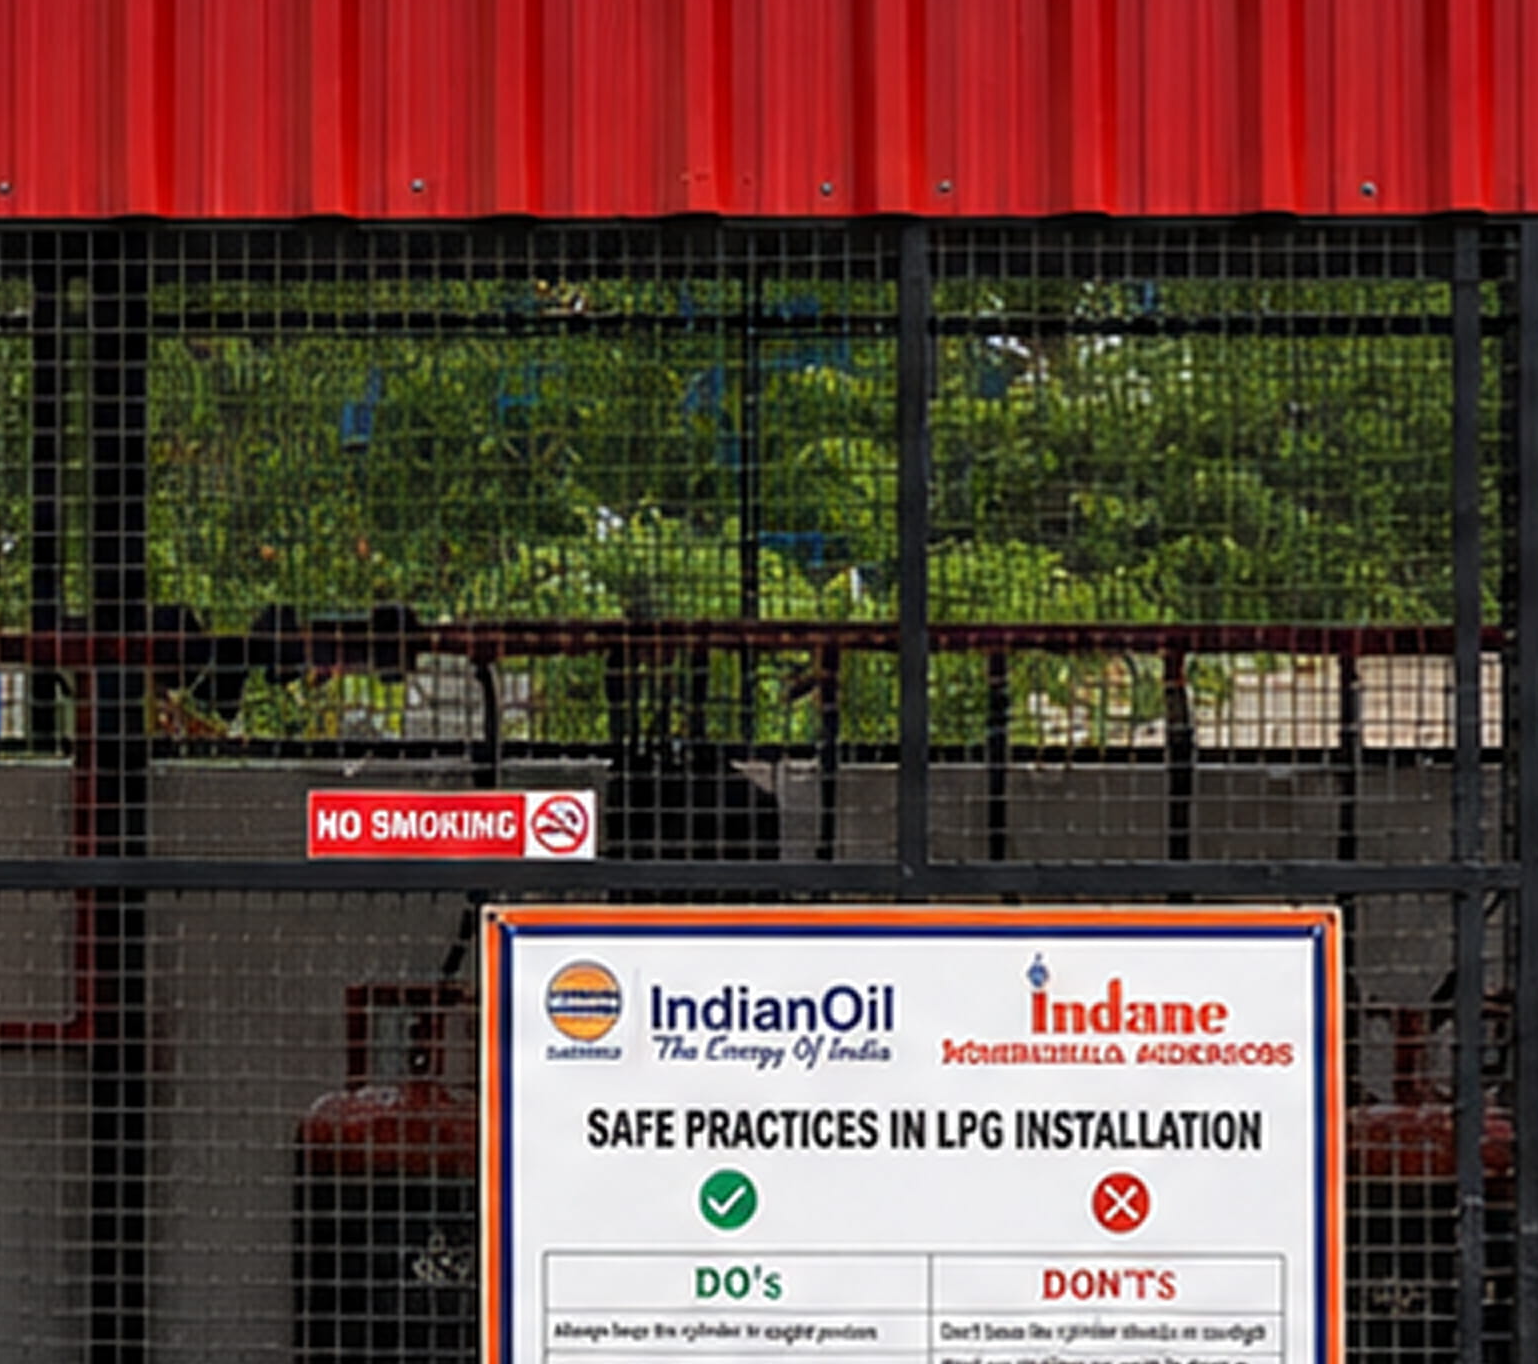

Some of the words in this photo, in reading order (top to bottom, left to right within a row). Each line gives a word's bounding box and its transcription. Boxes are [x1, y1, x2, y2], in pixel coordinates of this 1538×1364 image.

[371, 809, 517, 840] SMOKING
[651, 985, 894, 1032] IndianOil
[1028, 968, 1228, 1035] Indane
[587, 1108, 675, 1148] SAFE
[685, 1109, 879, 1149] PRACTICES
[890, 1110, 926, 1149] IN
[937, 1110, 1003, 1150] LPG
[1015, 1110, 1262, 1151] INSTALLATION
[696, 1265, 782, 1300] DO's
